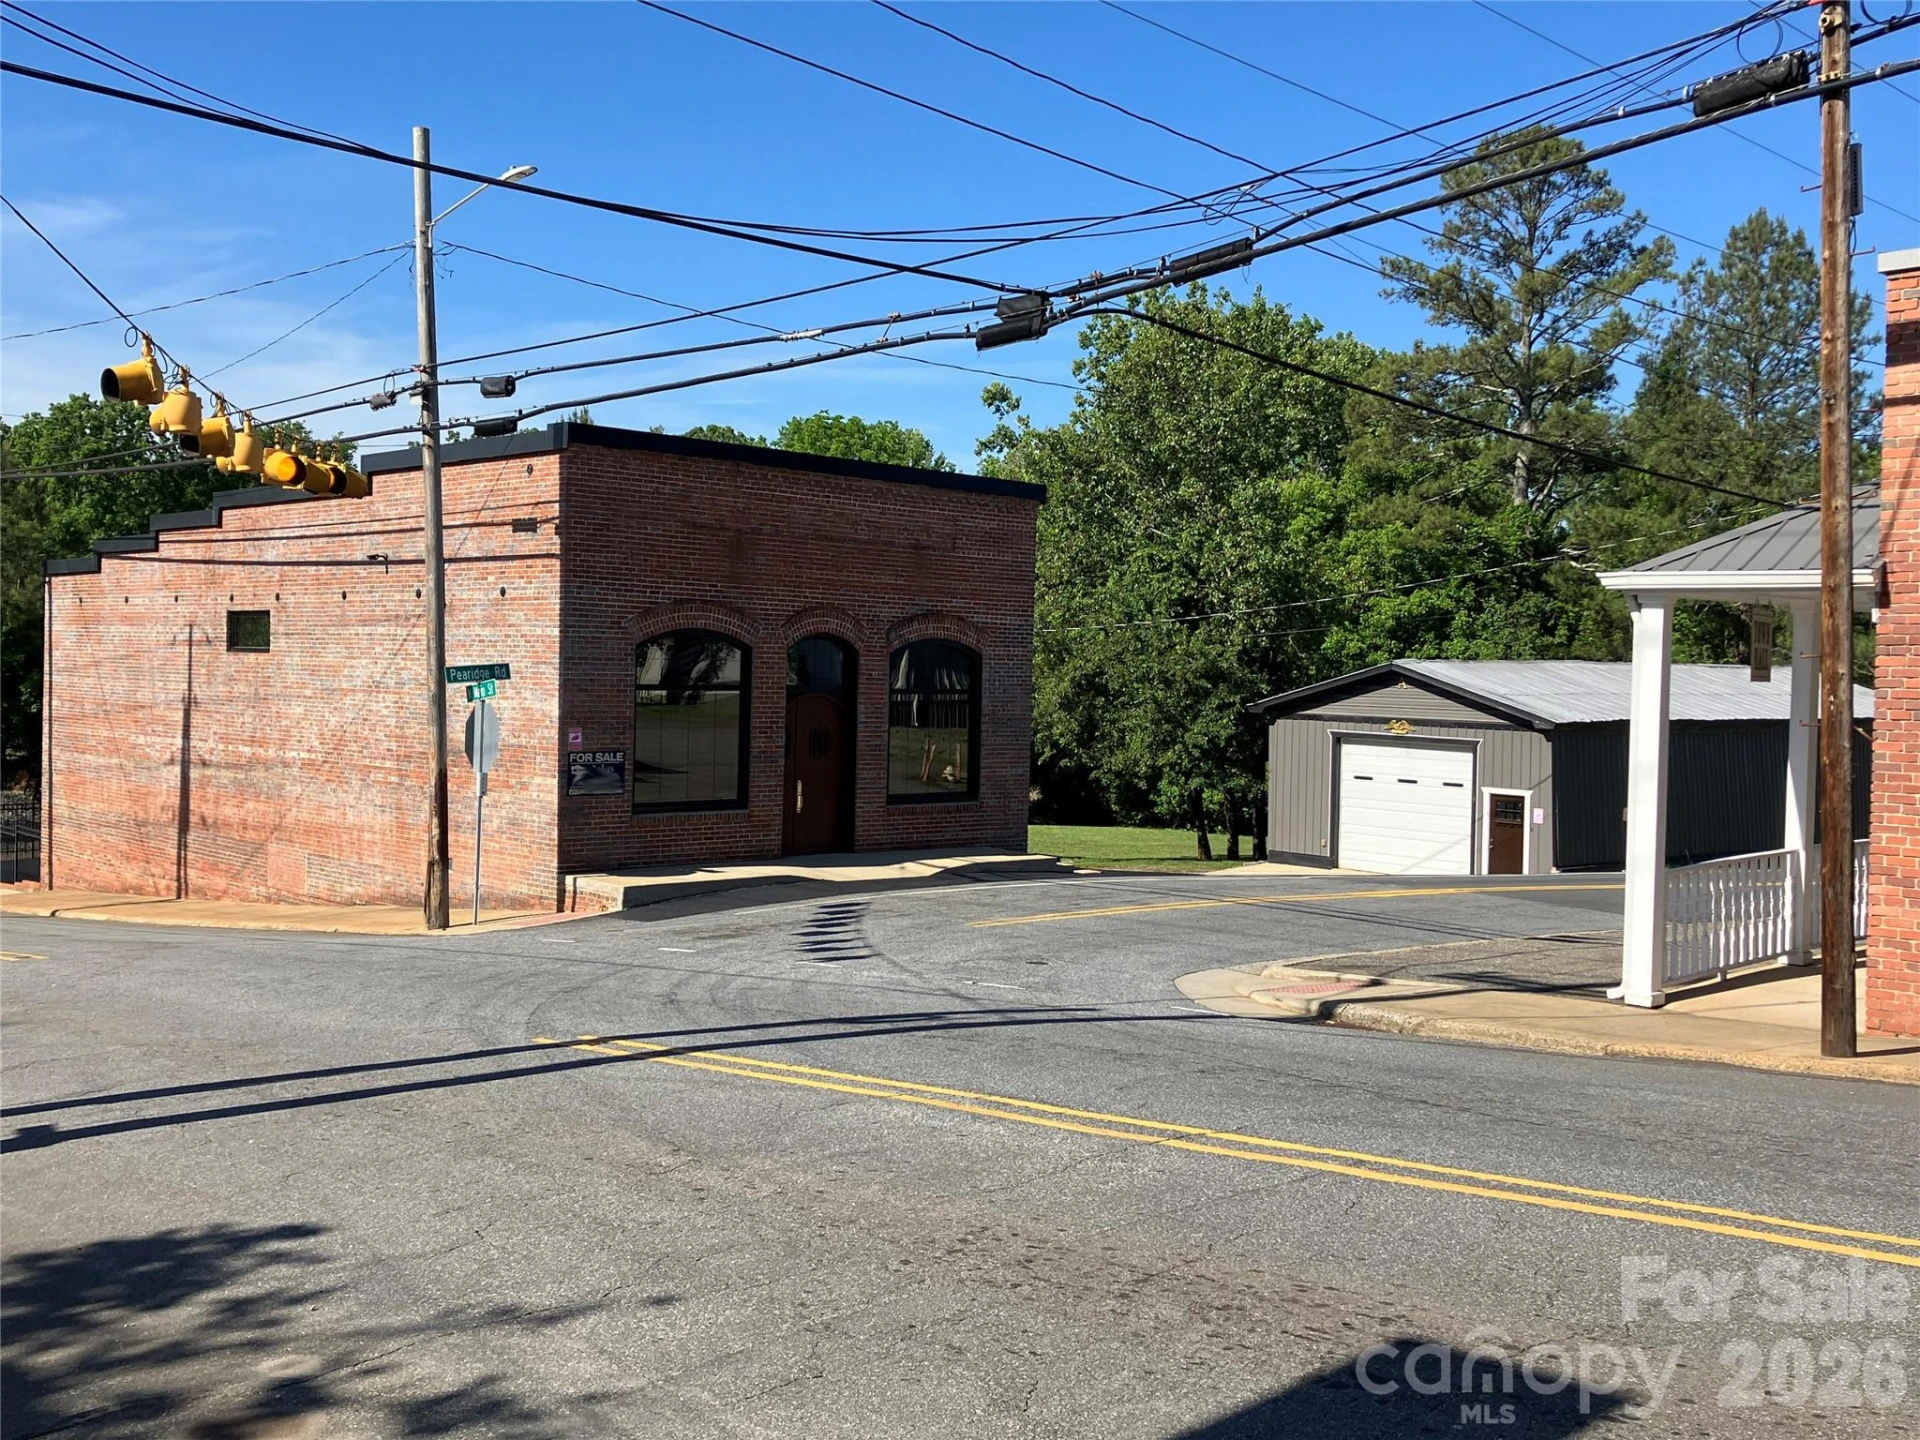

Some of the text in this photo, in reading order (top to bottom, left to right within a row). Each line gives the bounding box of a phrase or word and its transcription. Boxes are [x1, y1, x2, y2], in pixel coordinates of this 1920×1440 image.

[449, 666, 507, 681] Pearidge Rd
[487, 682, 494, 696] St
[569, 752, 624, 763] FOR SALE
